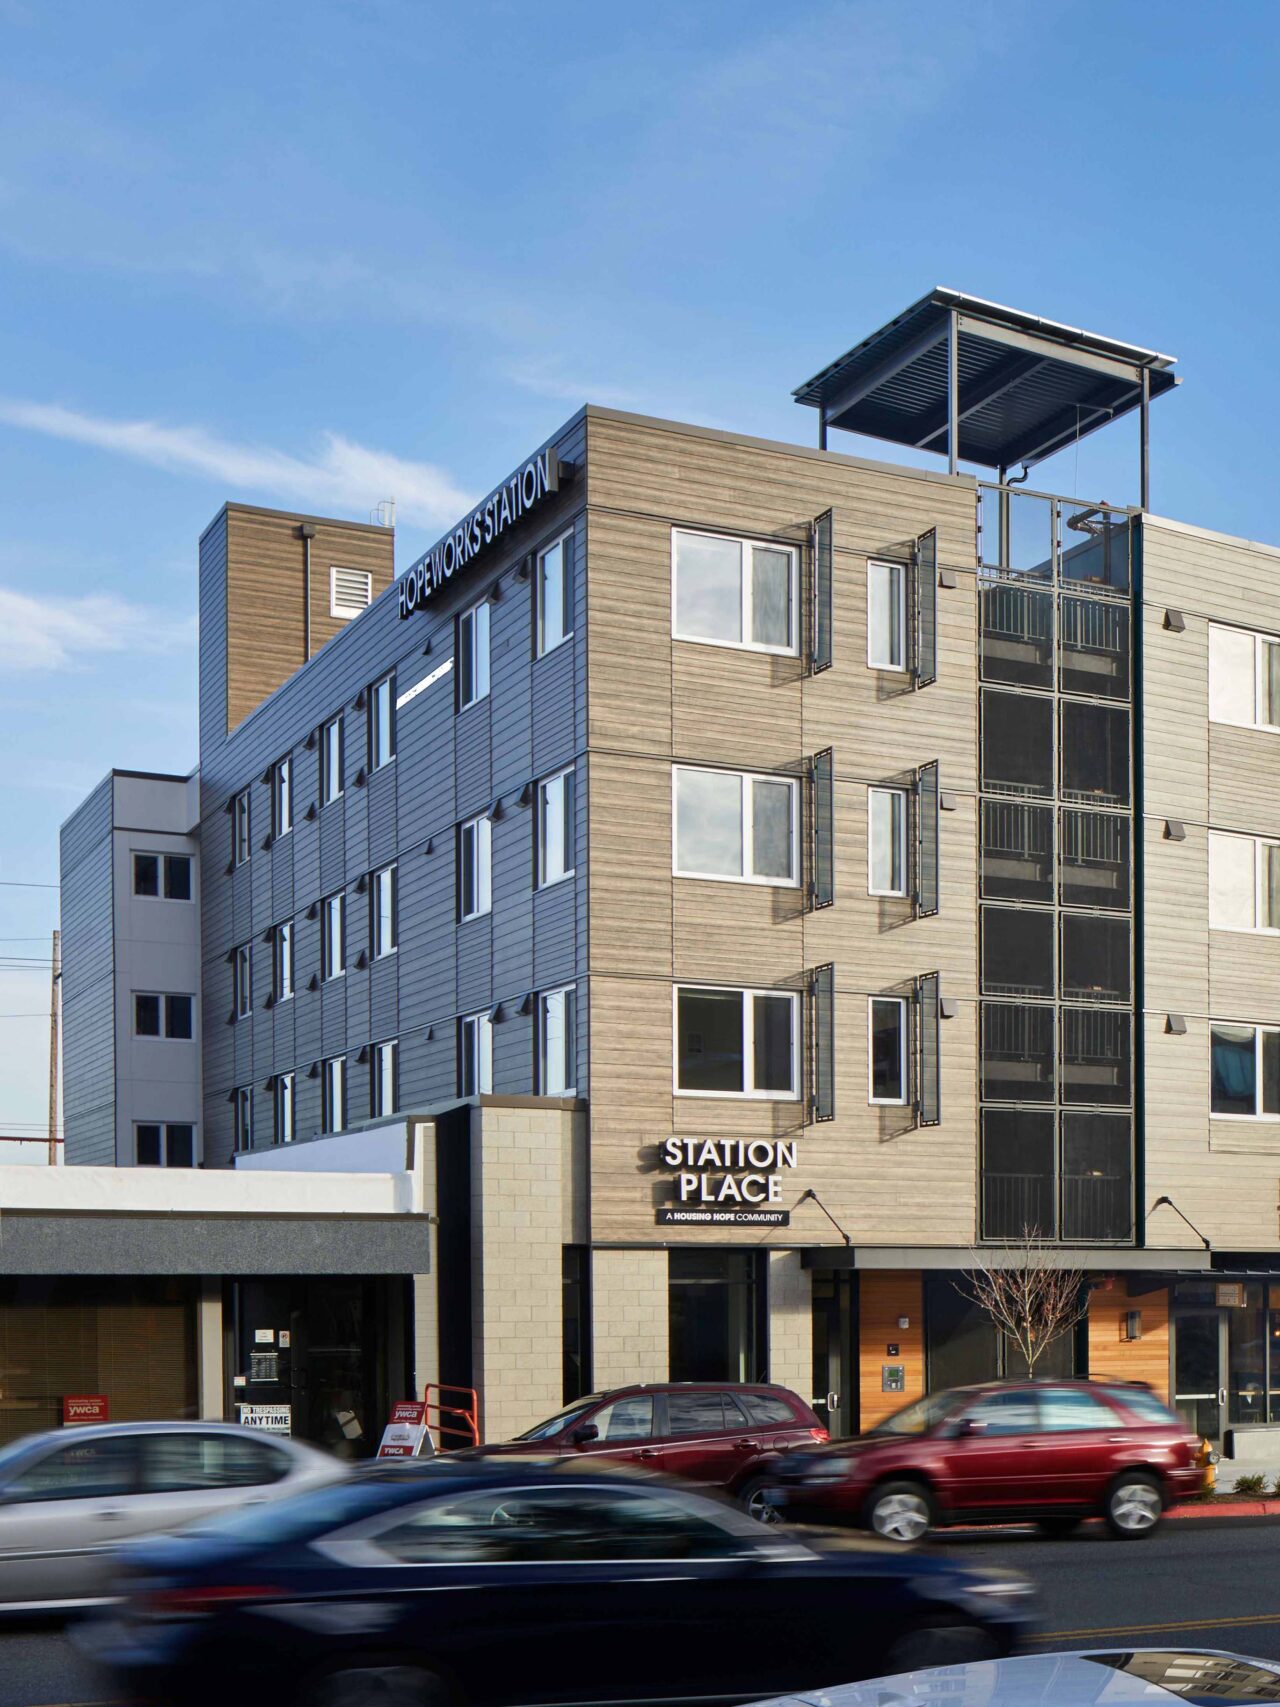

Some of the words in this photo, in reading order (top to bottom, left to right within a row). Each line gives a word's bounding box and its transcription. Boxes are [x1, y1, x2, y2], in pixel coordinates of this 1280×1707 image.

[398, 511, 482, 619] HOPEWORKS
[484, 448, 551, 544] STATION
[665, 1137, 797, 1168] STATION
[680, 1173, 783, 1202] PLACE
[674, 1212, 712, 1221] HOUSING
[713, 1213, 735, 1221] HOPE
[736, 1213, 783, 1222] COMMUNITY
[69, 1406, 100, 1416] ywca
[395, 1410, 418, 1419] ywca
[243, 1415, 289, 1425] ANYTIME
